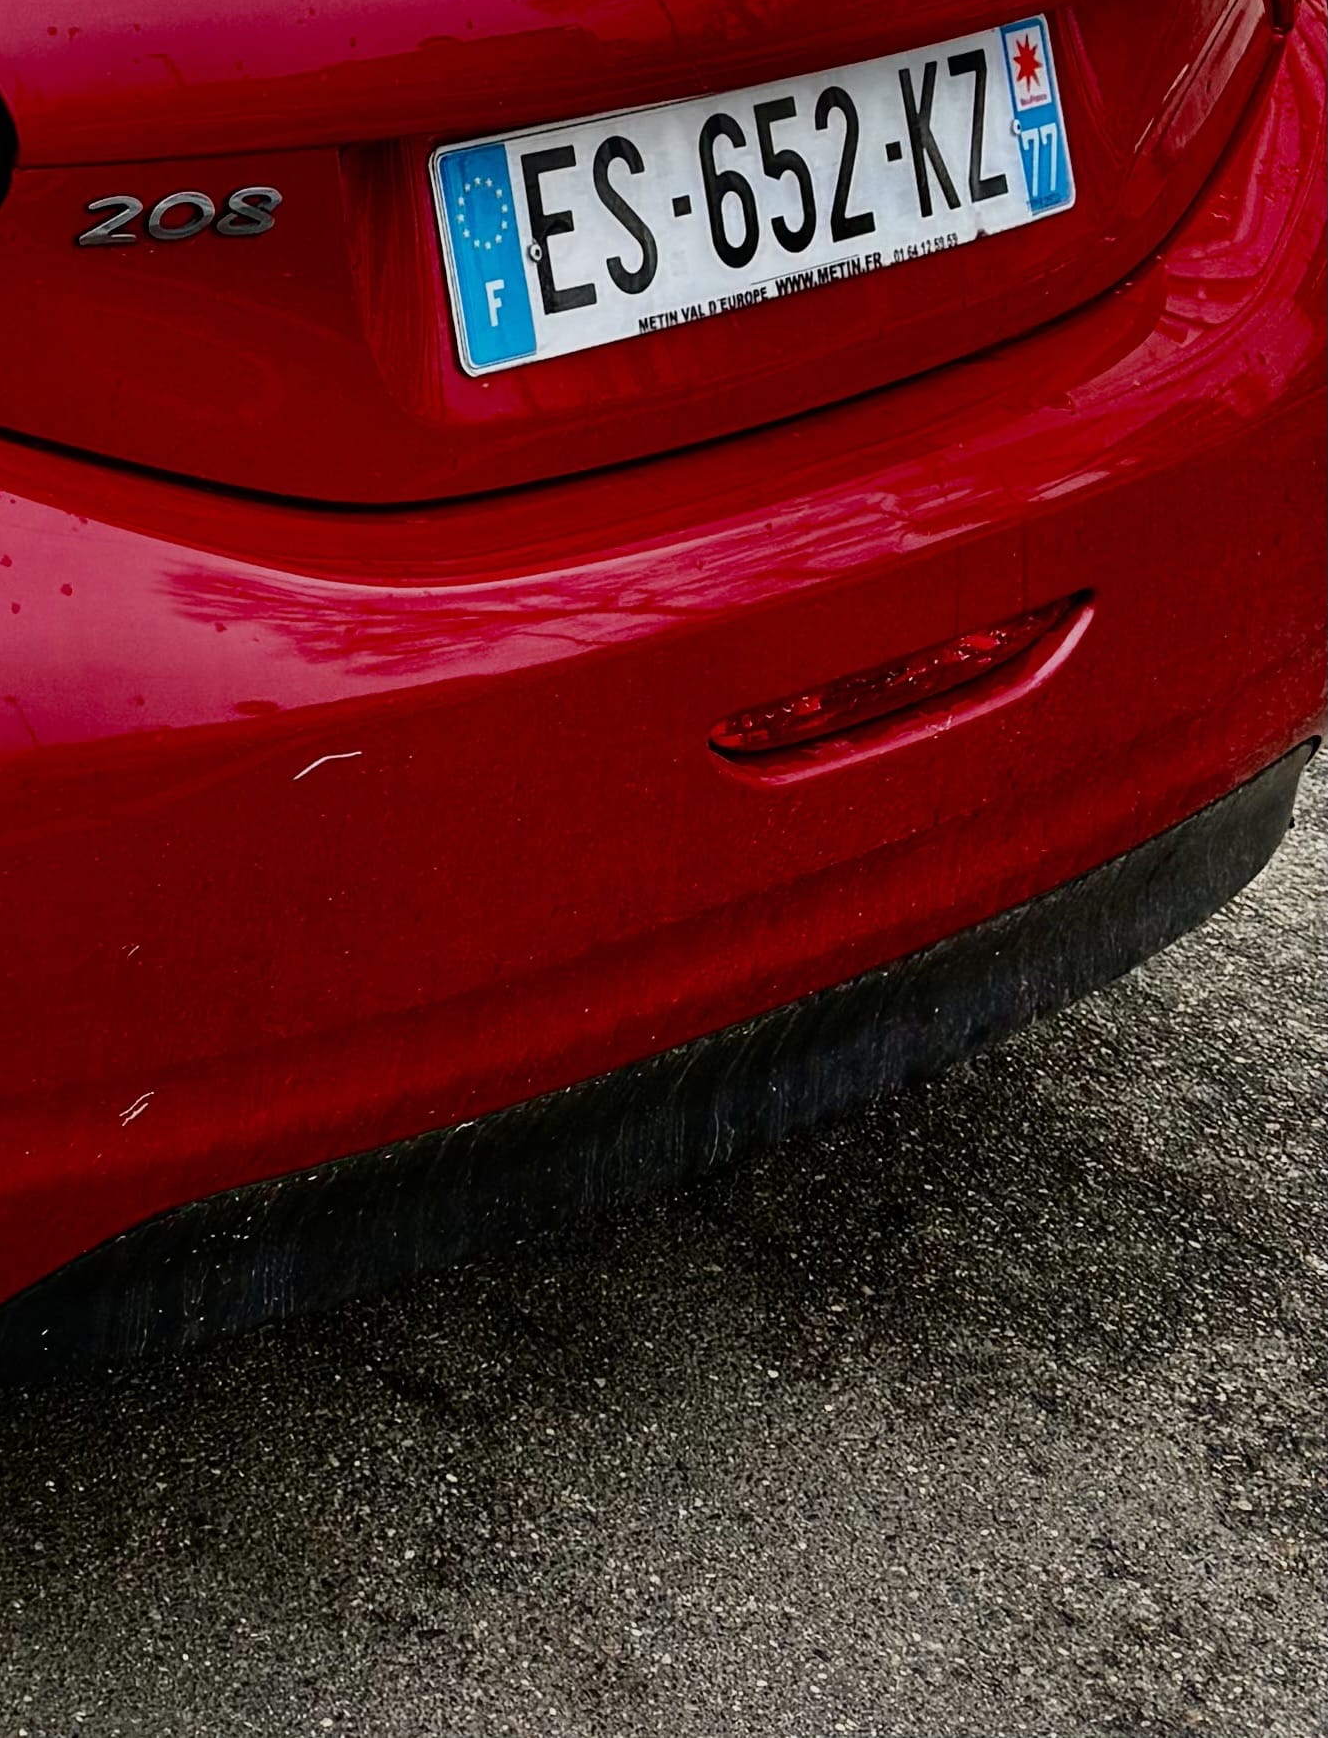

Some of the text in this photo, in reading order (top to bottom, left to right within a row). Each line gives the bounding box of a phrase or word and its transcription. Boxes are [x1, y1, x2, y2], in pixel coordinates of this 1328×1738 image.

[521, 49, 1008, 315] ES-652-KZ
[1022, 123, 1057, 197] 77
[79, 187, 283, 245] 208
[485, 279, 506, 327] F
[638, 311, 678, 333] METIN
[681, 305, 706, 323] VAL
[775, 252, 882, 297] WWW.METIN.FR
